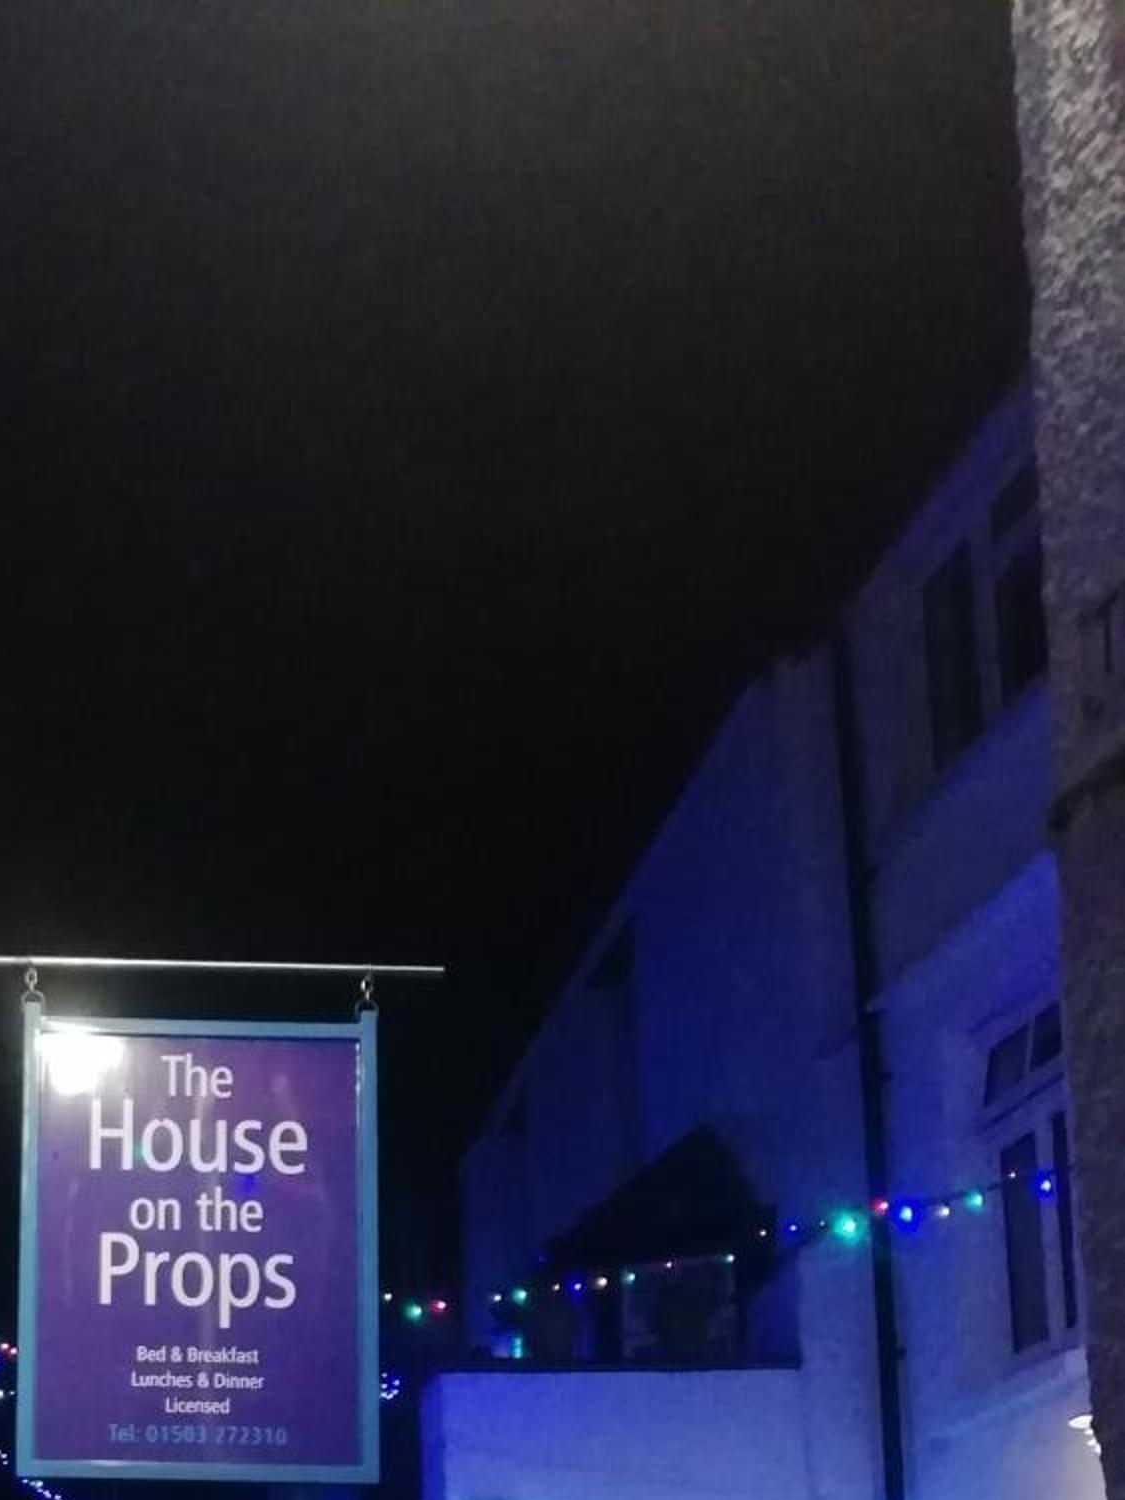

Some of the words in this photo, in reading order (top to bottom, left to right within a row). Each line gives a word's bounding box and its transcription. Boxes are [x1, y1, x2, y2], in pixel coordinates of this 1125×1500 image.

[161, 1052, 233, 1099] The
[89, 1099, 308, 1175] House
[129, 1197, 180, 1231] on
[195, 1186, 264, 1232] the
[98, 1232, 297, 1329] Props
[135, 1345, 166, 1363] Bed
[170, 1346, 183, 1363] &
[186, 1346, 259, 1365] Breakfast
[130, 1370, 192, 1389] Lunches
[196, 1372, 210, 1389] &
[213, 1373, 265, 1390] Dinner
[165, 1397, 230, 1415] Licensed
[108, 1424, 140, 1443] Tel:
[145, 1425, 207, 1444] 01503
[215, 1426, 288, 1446] 272310
